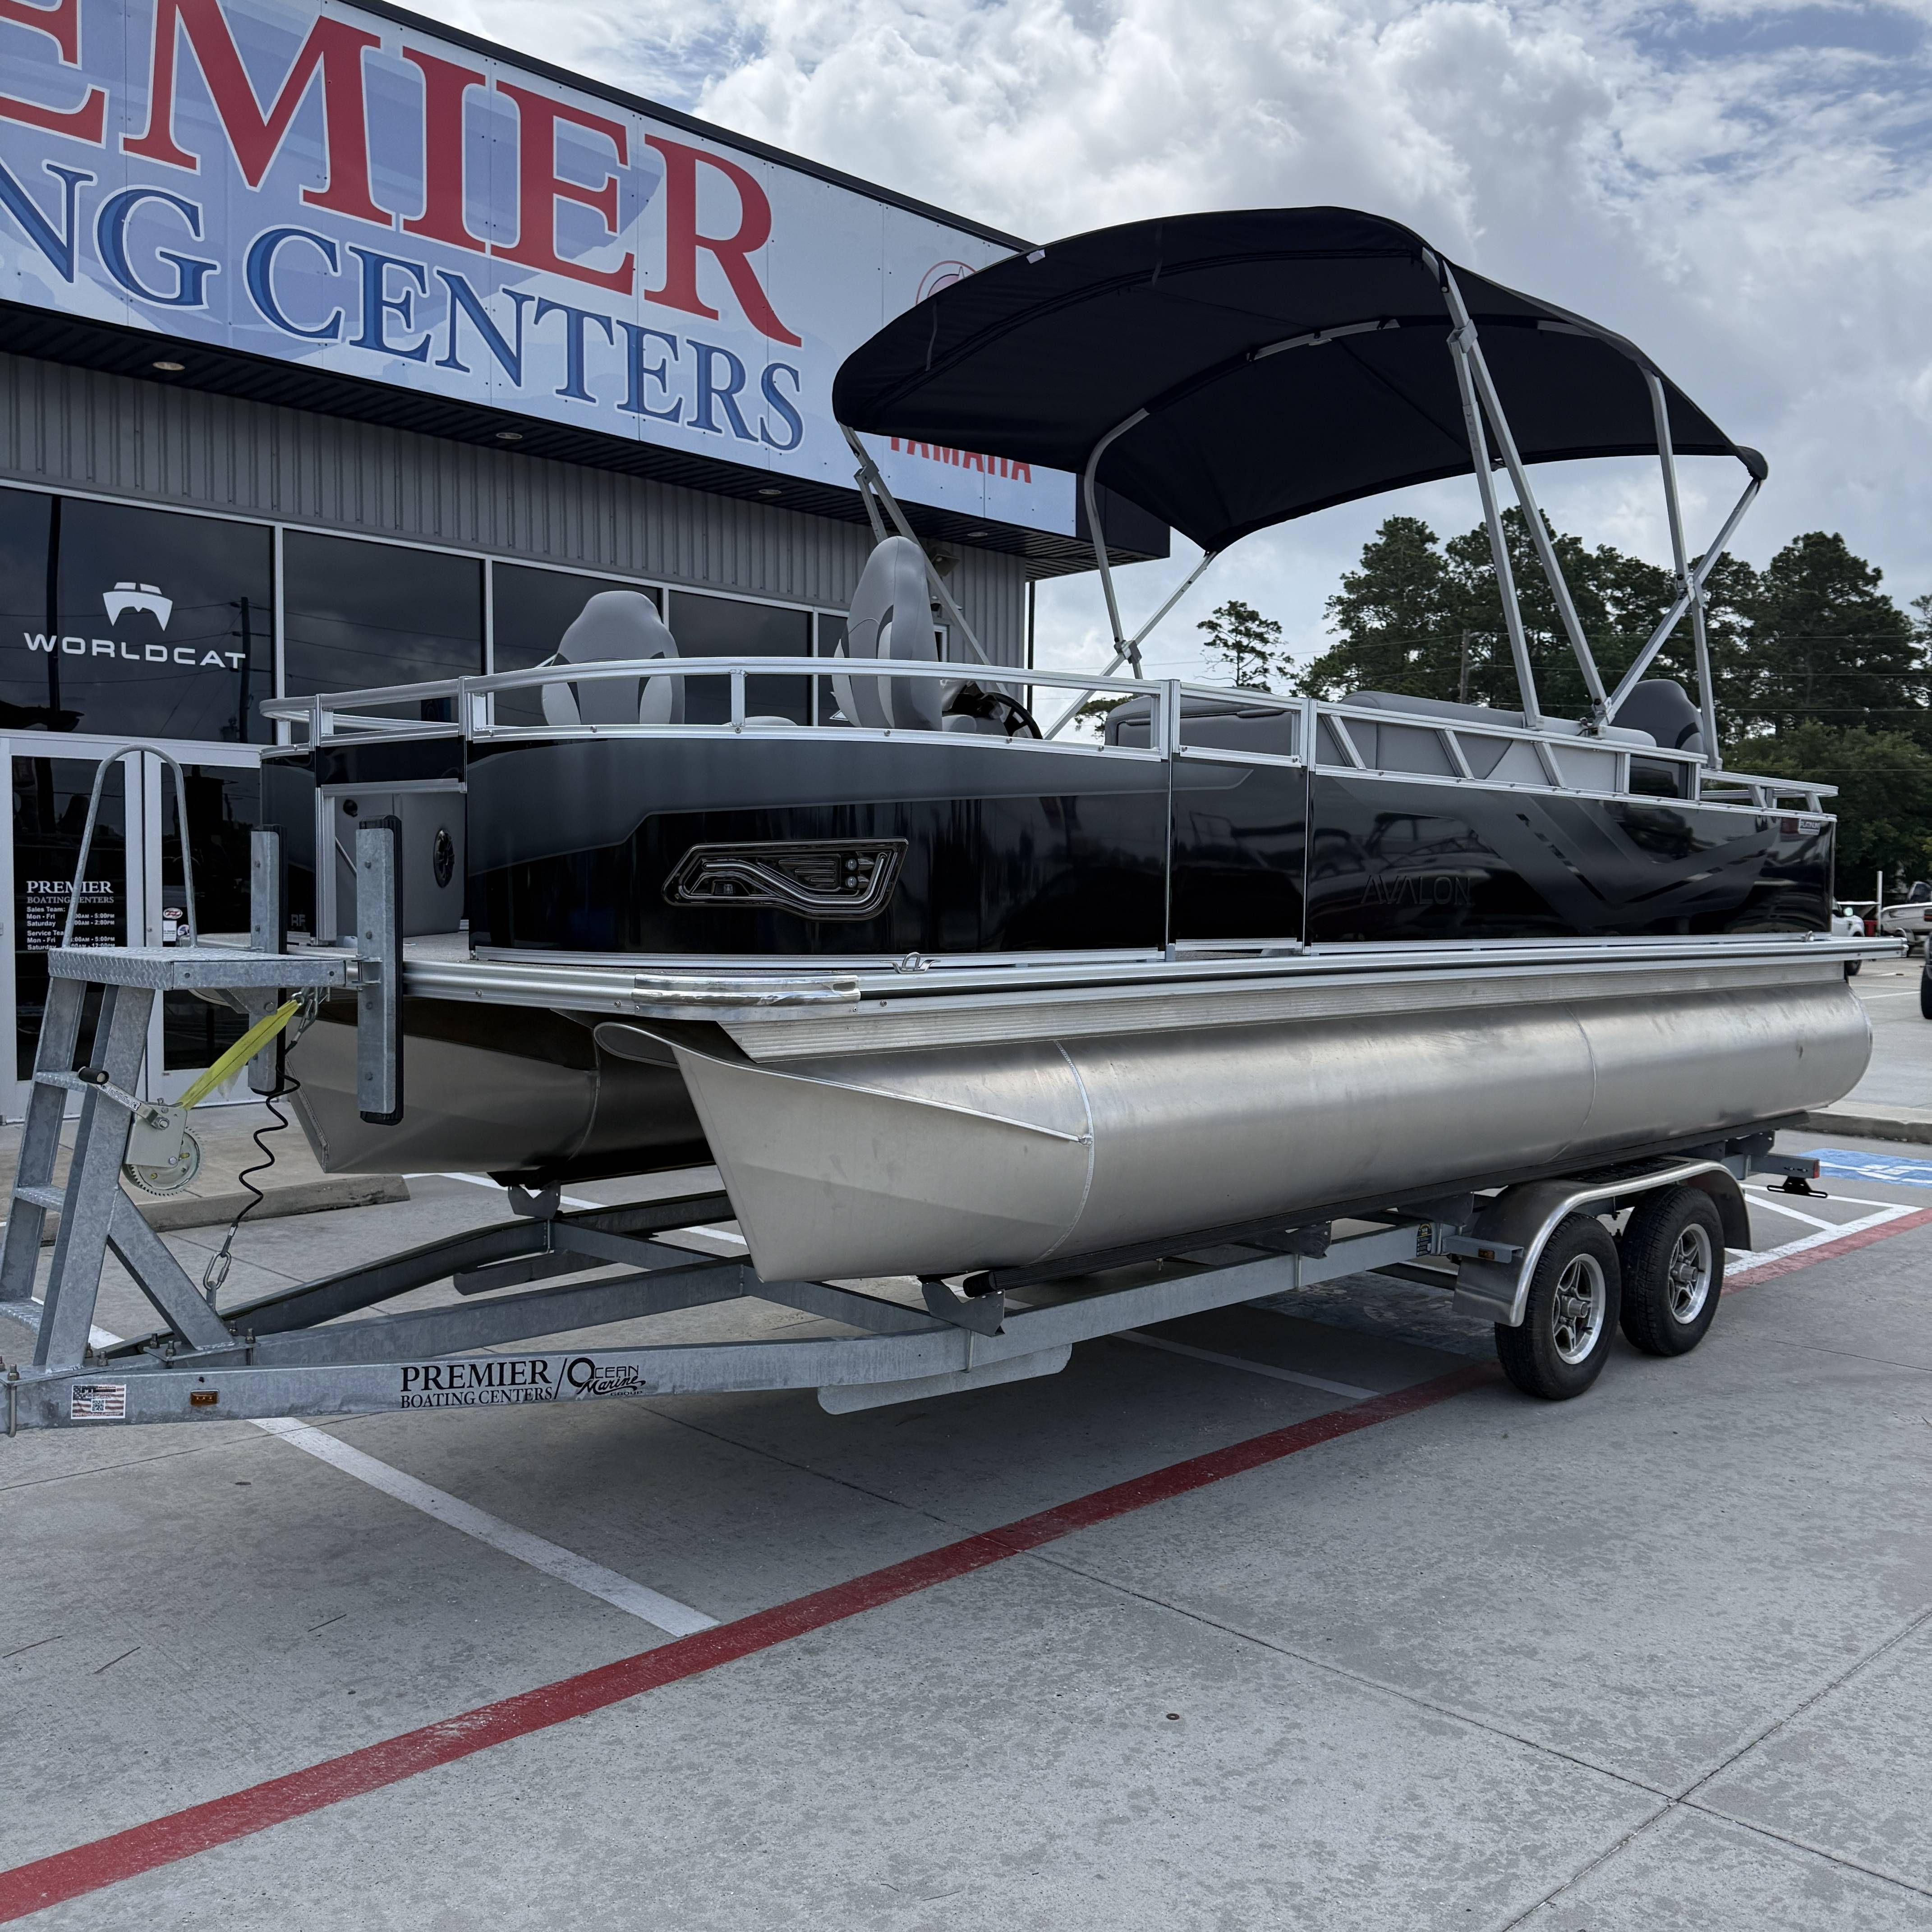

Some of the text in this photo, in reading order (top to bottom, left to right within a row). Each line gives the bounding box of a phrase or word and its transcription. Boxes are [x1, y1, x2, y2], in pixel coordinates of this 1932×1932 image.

[246, 227, 803, 451] CENTERS
[24, 632, 246, 669] WORLDCAT
[1361, 875, 1471, 905] AVALON
[400, 1359, 552, 1392] PREMIER
[567, 1357, 639, 1388] OCEAN
[576, 1375, 646, 1395] Marine
[400, 1387, 553, 1408] BOATING CENTERS
